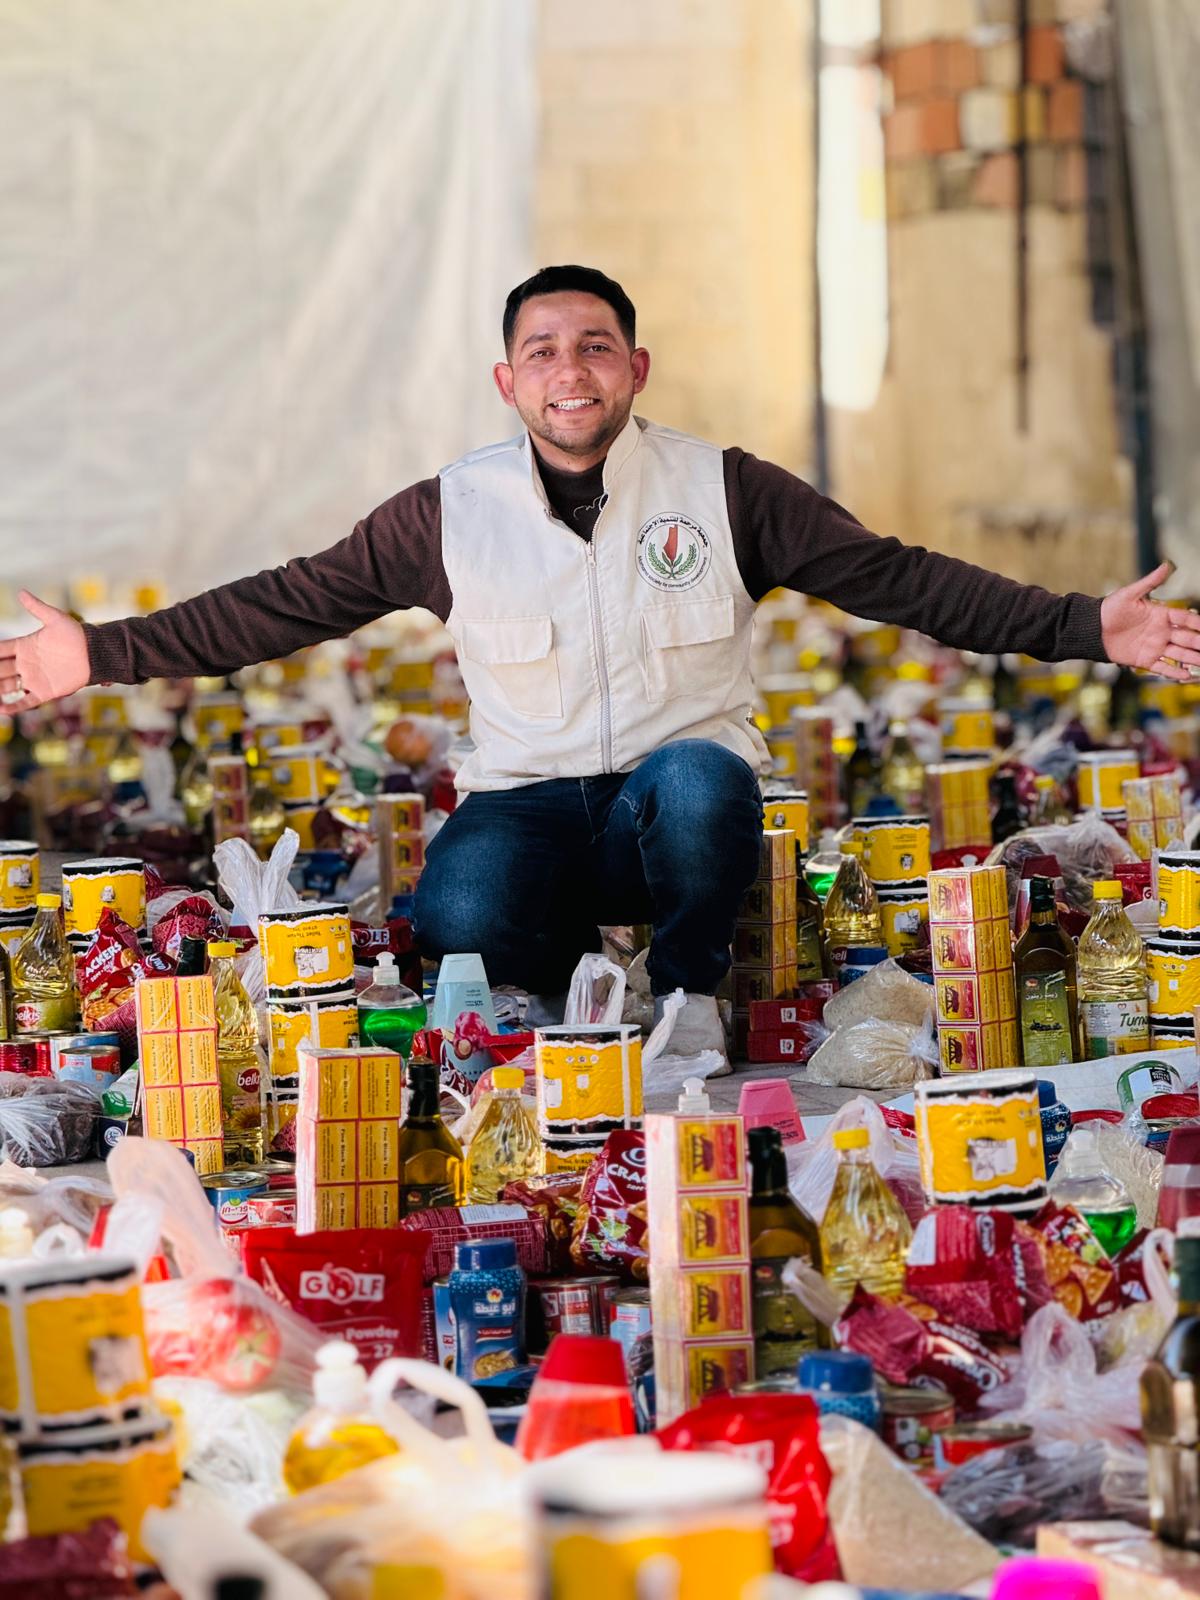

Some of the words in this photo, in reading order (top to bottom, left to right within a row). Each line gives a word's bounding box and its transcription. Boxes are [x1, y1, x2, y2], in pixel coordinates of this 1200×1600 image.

[85, 941, 122, 978] ACKERS
[608, 1164, 647, 1184] CRAC
[304, 1266, 384, 1304] GOLF
[346, 1325, 399, 1340] Powder
[374, 1343, 394, 1358] 27
